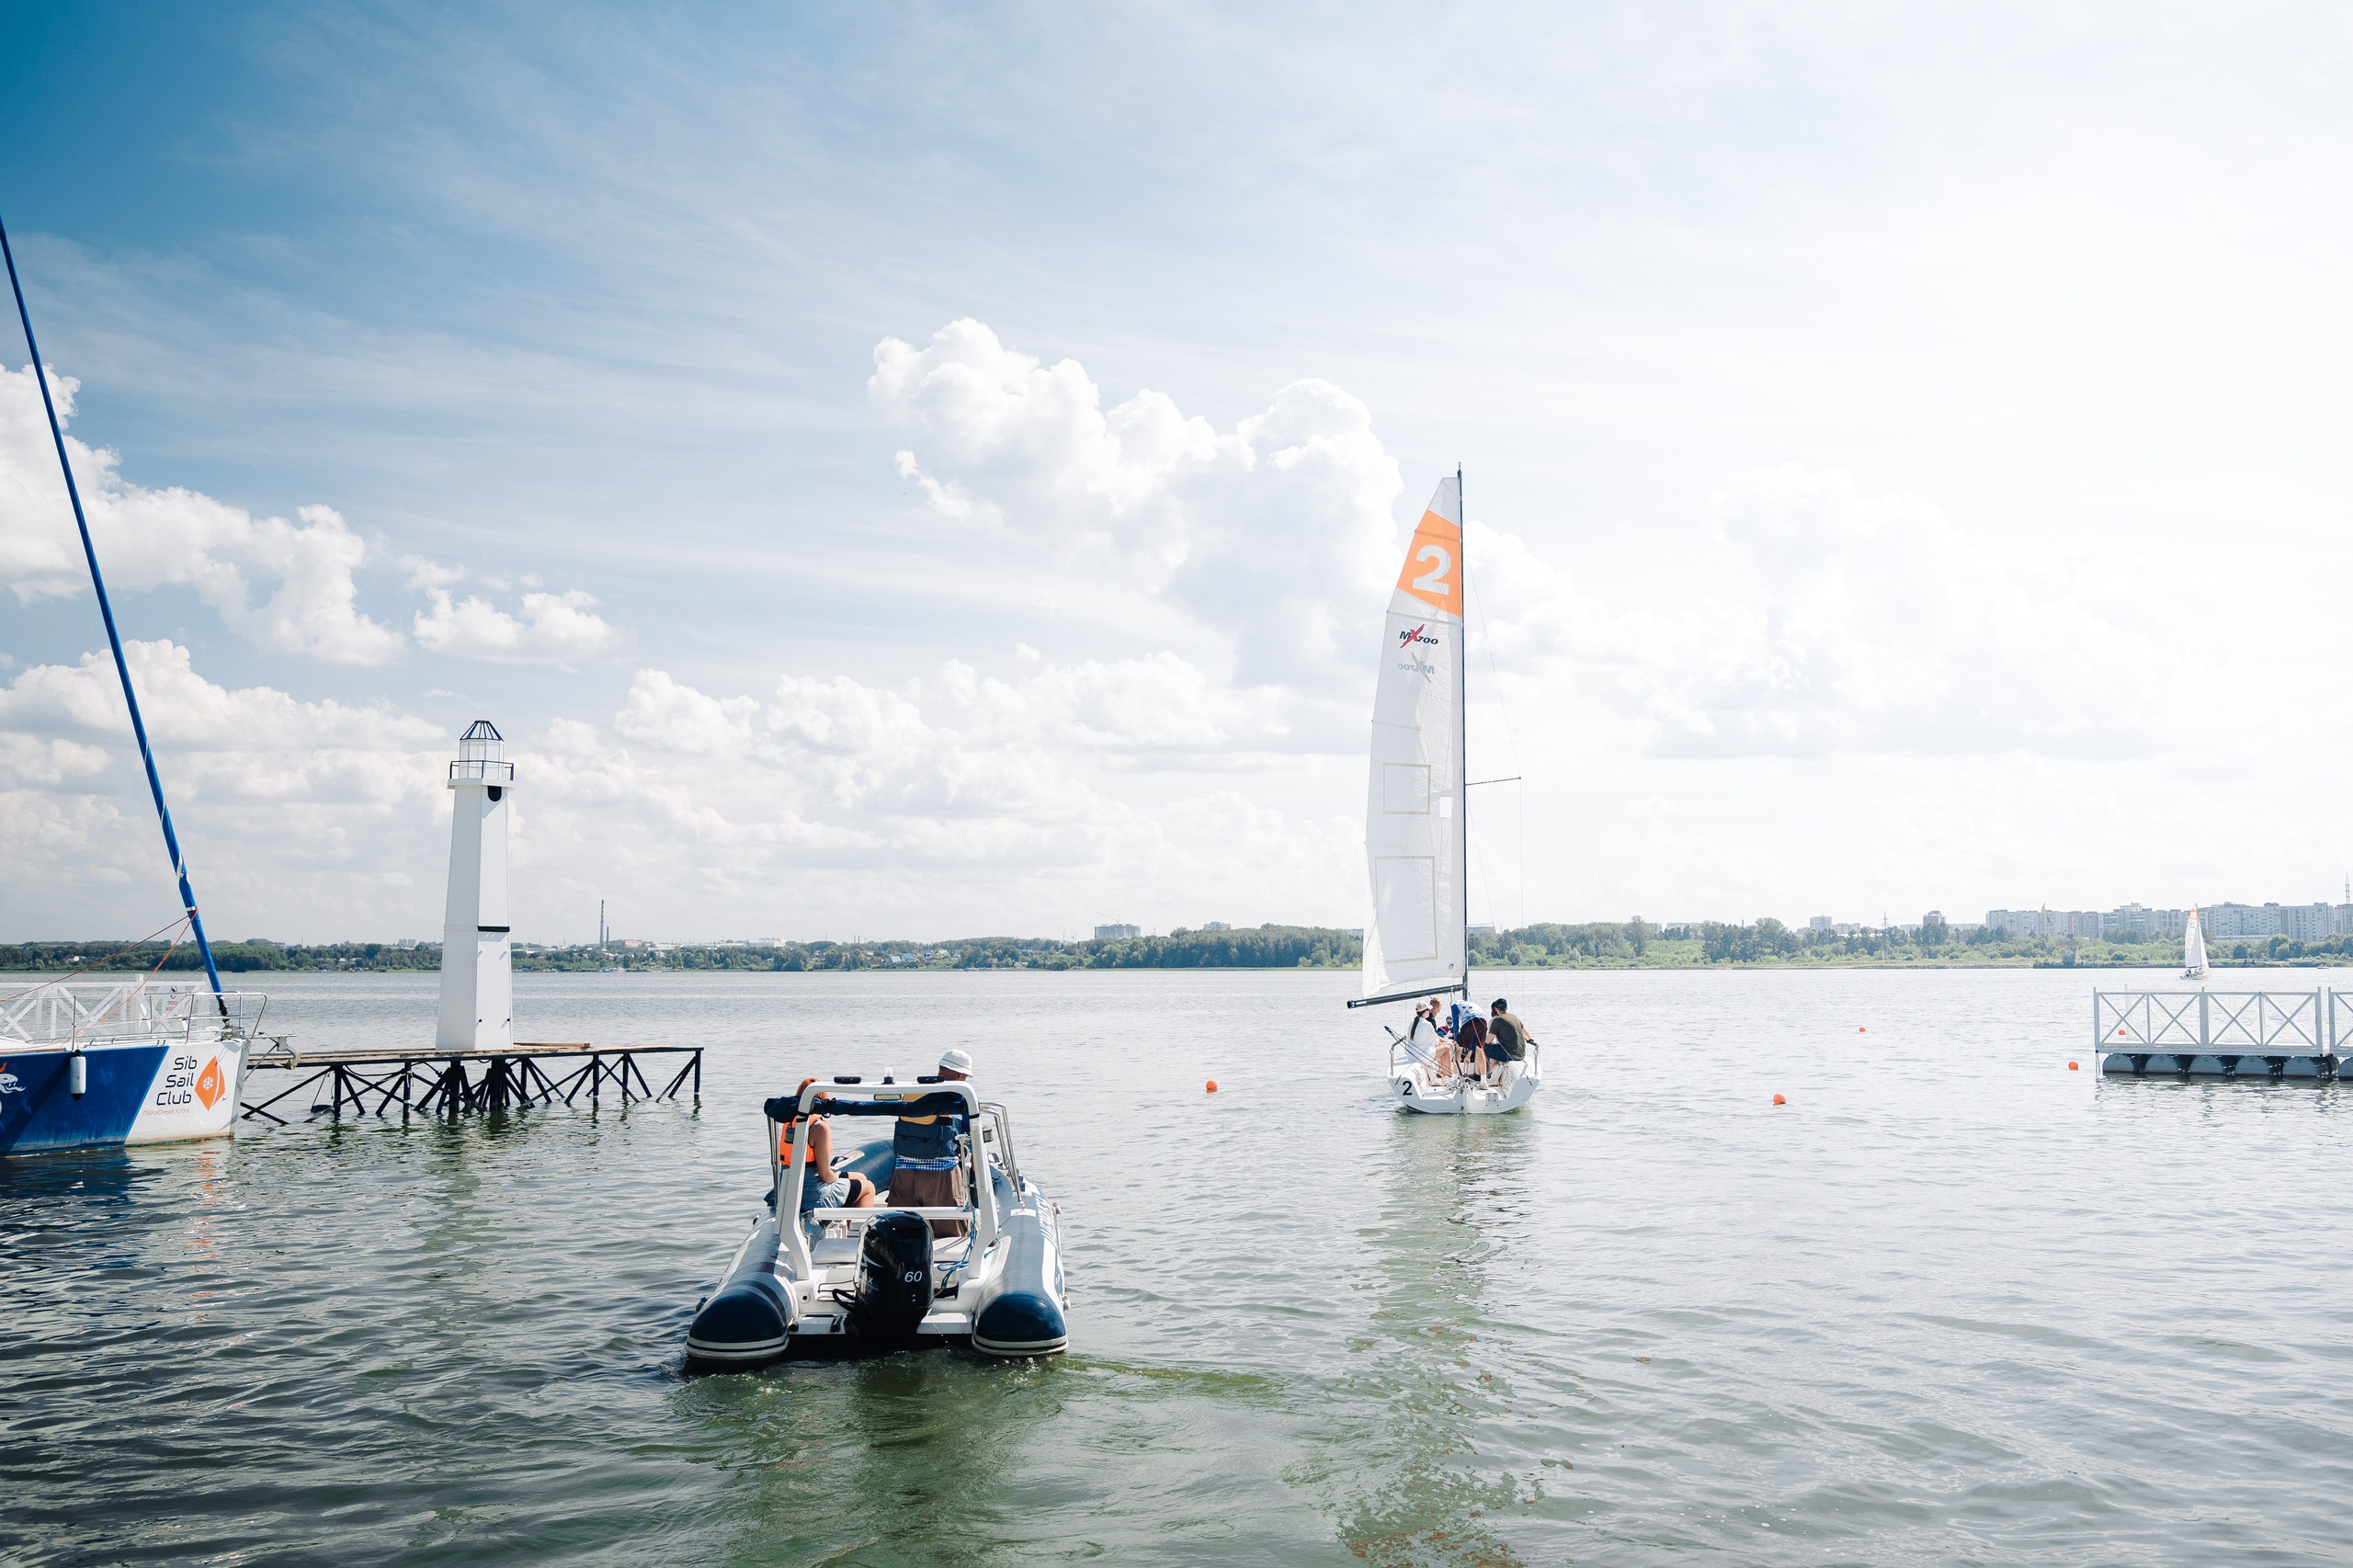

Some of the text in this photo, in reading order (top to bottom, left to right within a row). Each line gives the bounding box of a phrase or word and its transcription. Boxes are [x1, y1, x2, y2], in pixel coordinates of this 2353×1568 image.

[1413, 544, 1450, 596] 2
[1399, 623, 1439, 649] MX700
[173, 1055, 198, 1071] Sib
[165, 1073, 194, 1088] Sail
[1402, 1080, 1413, 1096] 2
[156, 1090, 192, 1106] Club
[904, 1270, 923, 1283] 60
